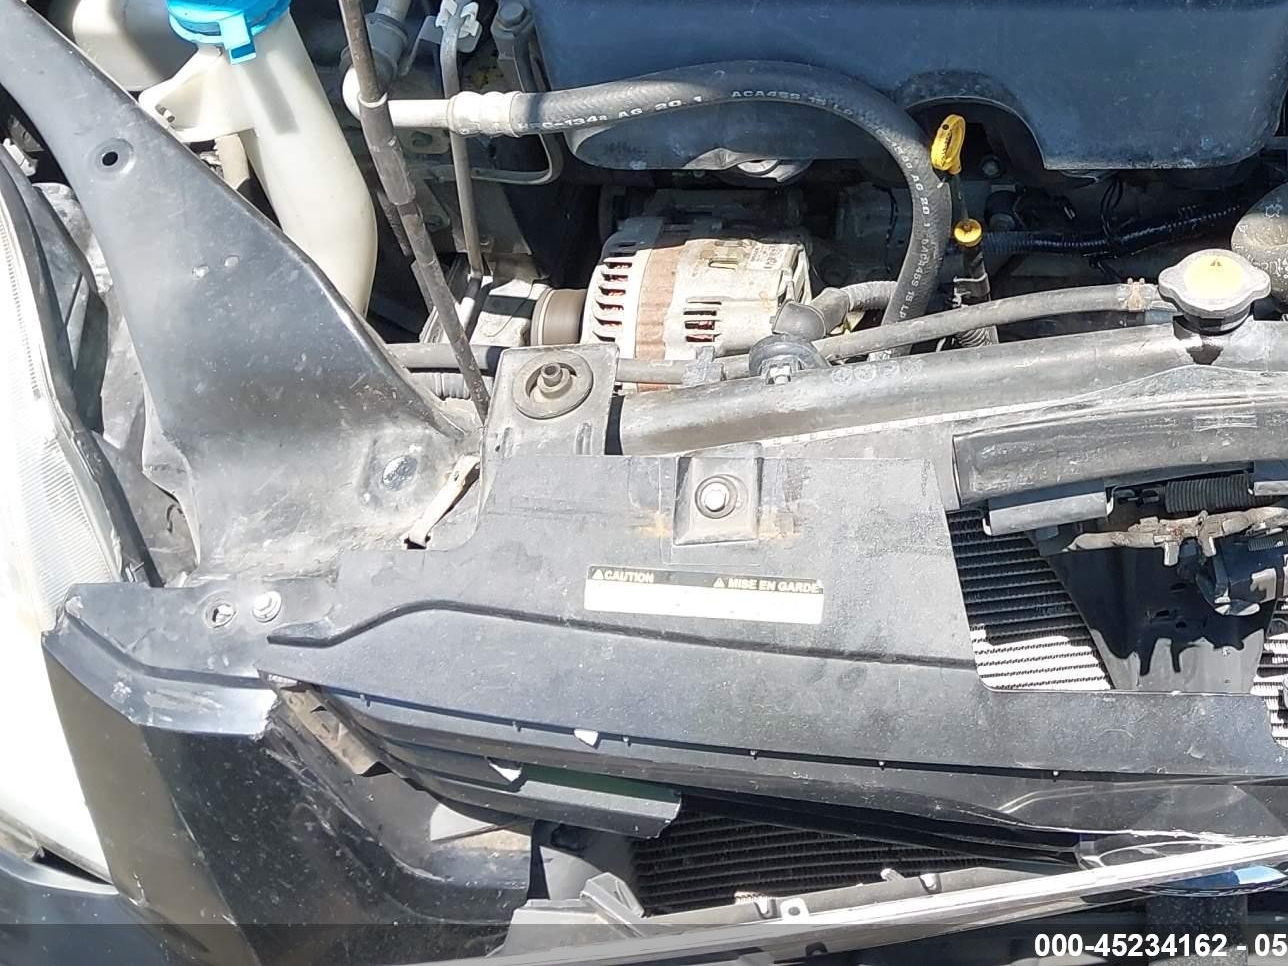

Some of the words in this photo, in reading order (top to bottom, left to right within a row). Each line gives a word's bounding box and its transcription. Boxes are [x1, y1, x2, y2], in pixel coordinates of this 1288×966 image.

[618, 107, 643, 119] AG
[911, 174, 924, 191] AG
[604, 569, 654, 583] CAUTION
[727, 578, 757, 590] MISE
[758, 579, 775, 592] EN
[777, 580, 821, 594] GARDE
